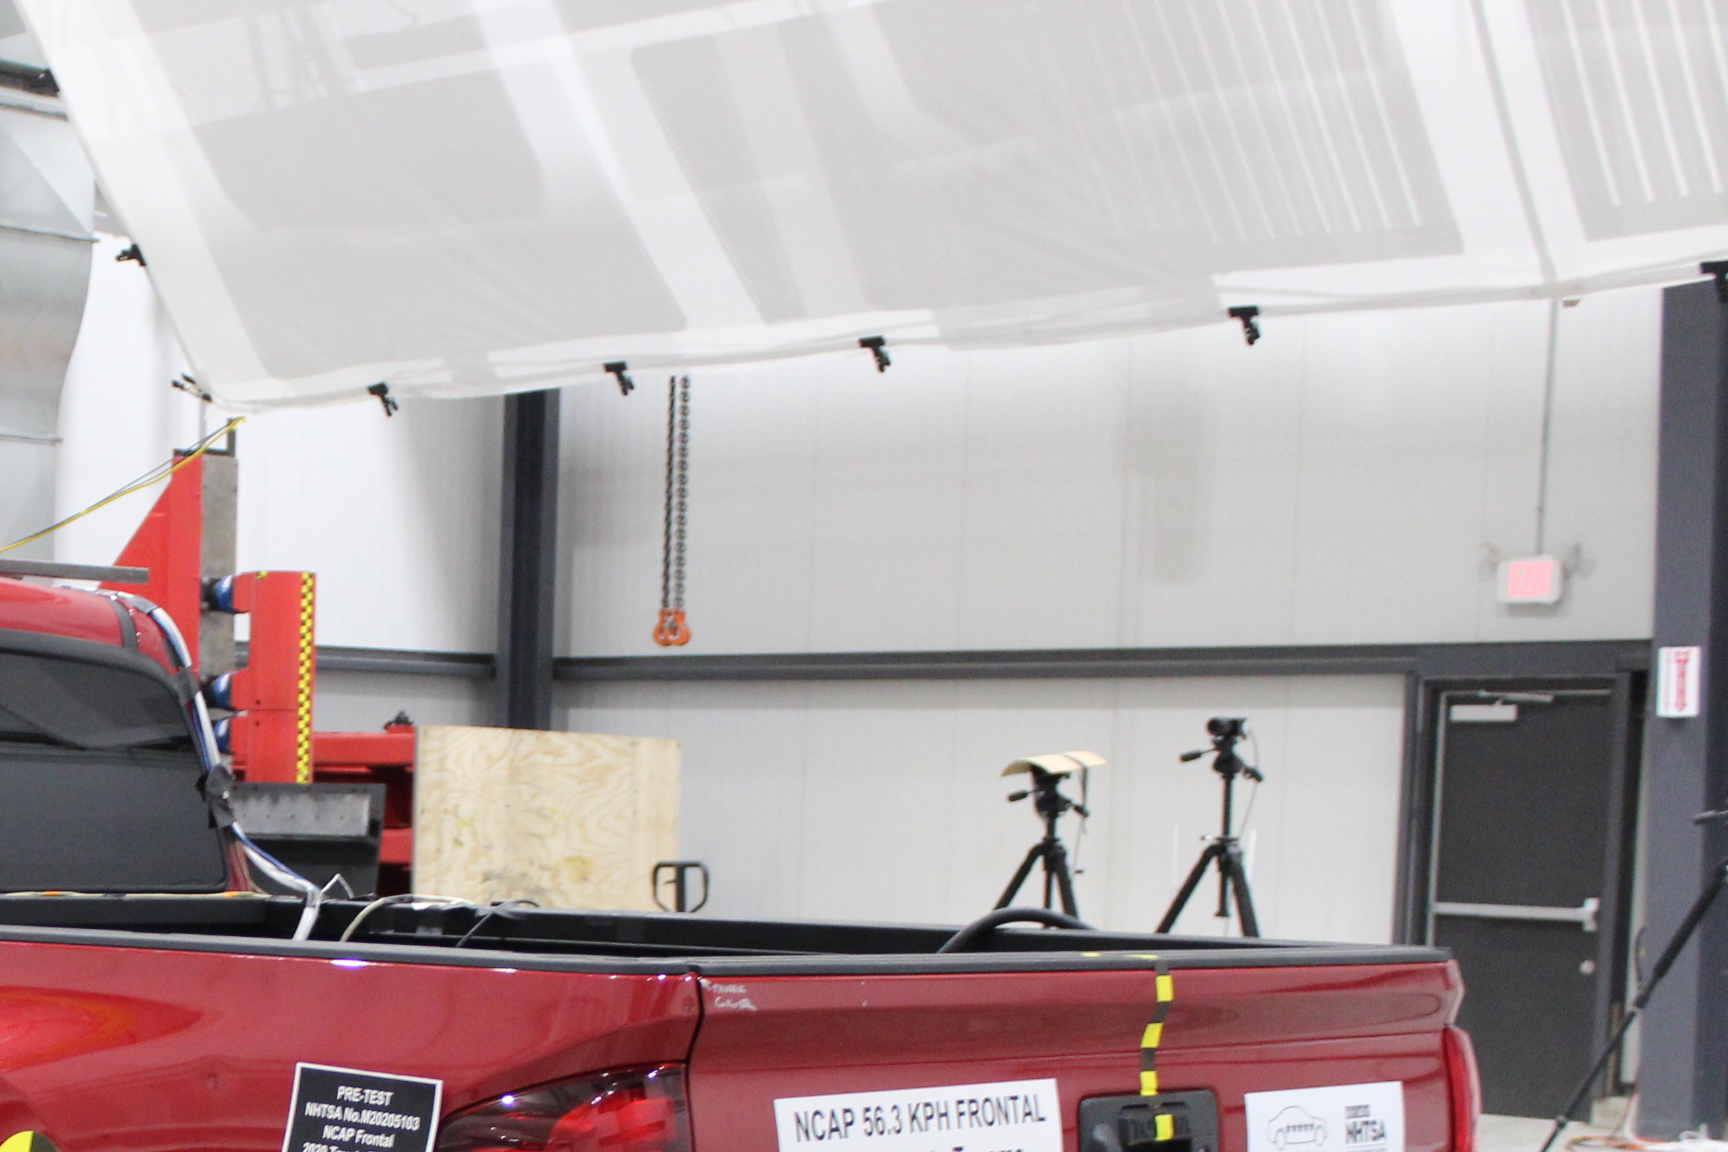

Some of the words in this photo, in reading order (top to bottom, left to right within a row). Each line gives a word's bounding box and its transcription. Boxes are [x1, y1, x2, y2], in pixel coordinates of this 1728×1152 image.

[336, 1085, 394, 1107] PRE-TEST
[304, 1101, 343, 1122] NHTSA
[794, 1107, 855, 1143] NCAP
[862, 1103, 903, 1137] 56.3
[907, 1099, 951, 1134] KPH
[955, 1093, 1046, 1130] FRONTAL
[322, 1124, 356, 1142] NCAP
[355, 1129, 395, 1148] Frontal
[1345, 1119, 1387, 1145] NHTSA
